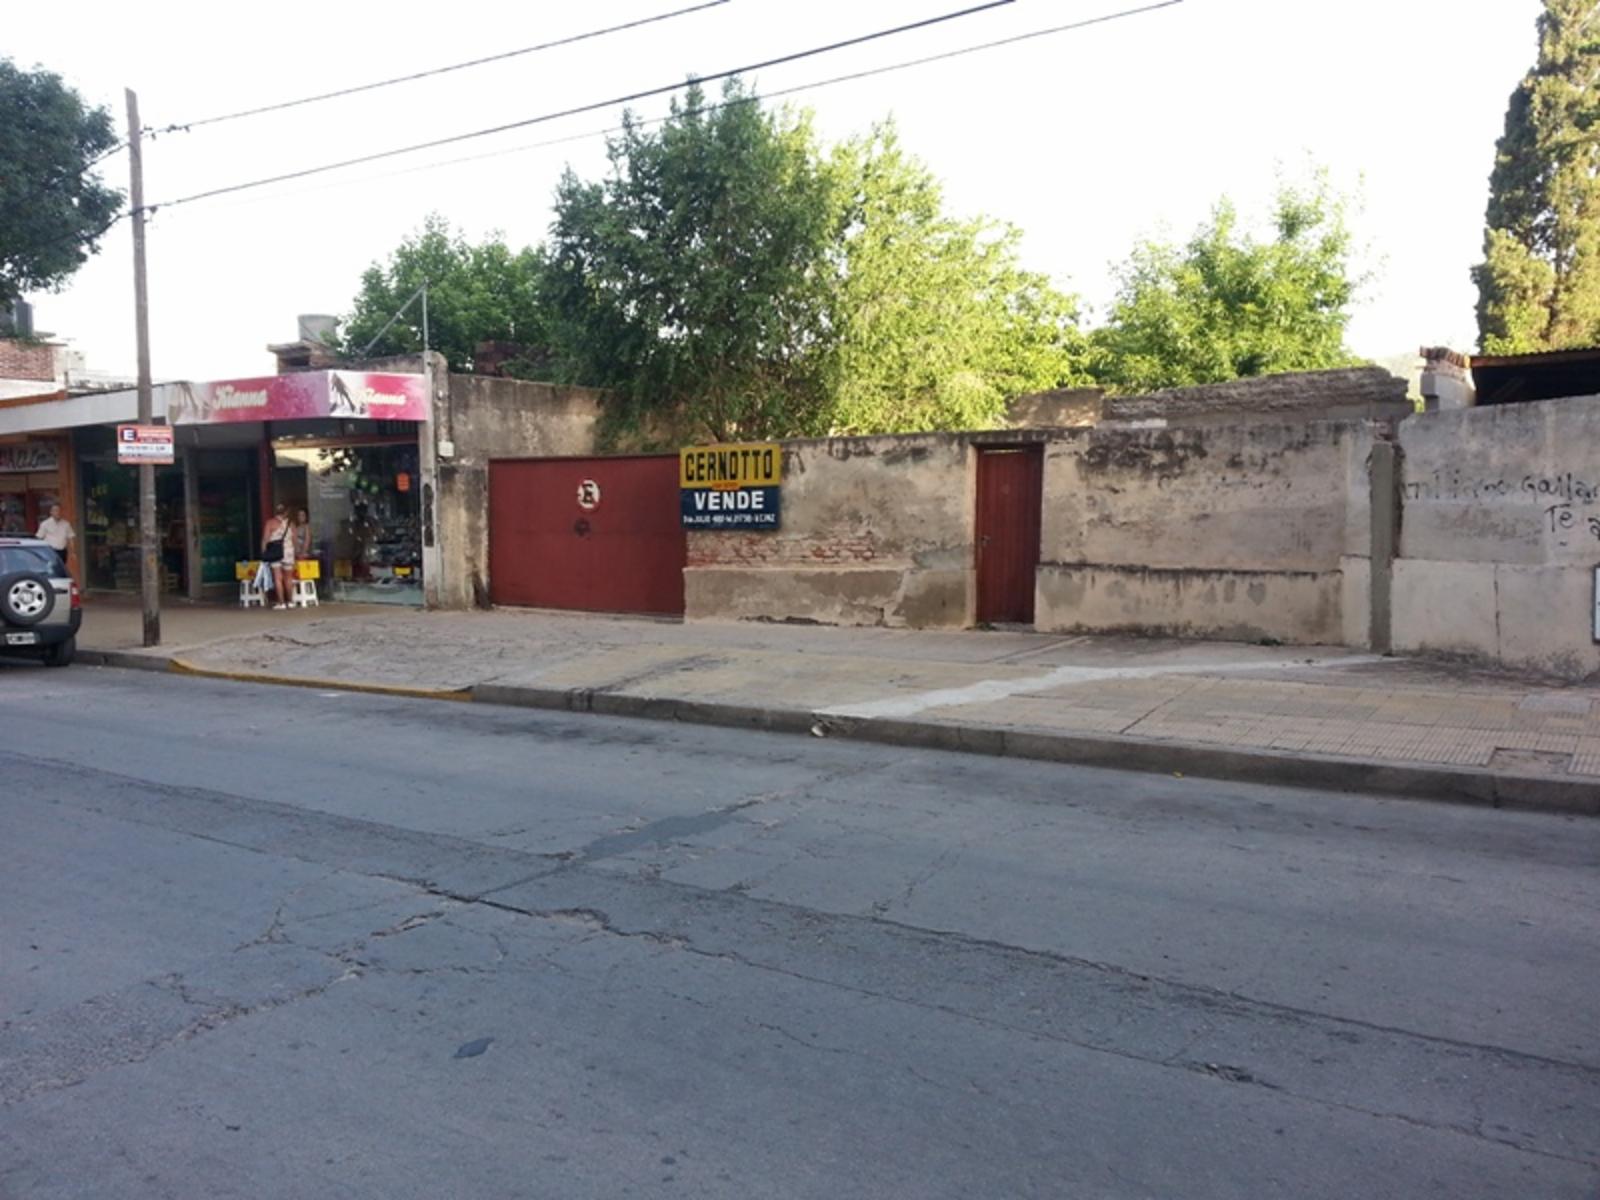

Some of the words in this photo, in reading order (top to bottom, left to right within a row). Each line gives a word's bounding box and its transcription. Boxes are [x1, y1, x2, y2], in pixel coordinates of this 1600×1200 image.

[123, 429, 135, 441] E
[685, 449, 773, 481] CERNOTTO
[694, 490, 764, 511] VENDE
[1543, 503, 1576, 533] Te
